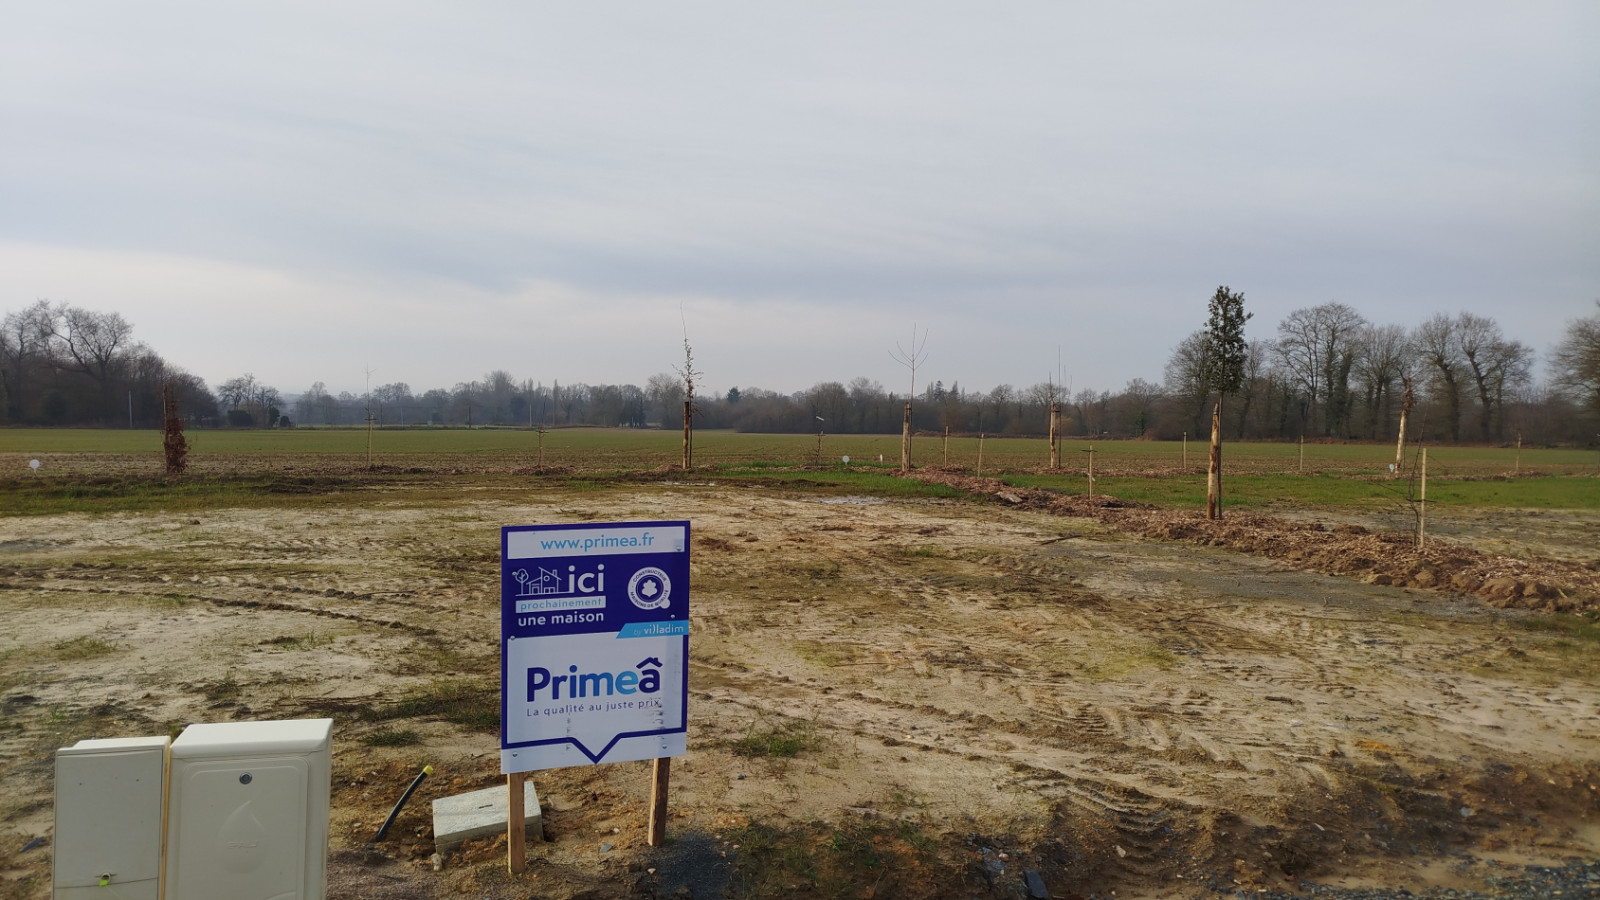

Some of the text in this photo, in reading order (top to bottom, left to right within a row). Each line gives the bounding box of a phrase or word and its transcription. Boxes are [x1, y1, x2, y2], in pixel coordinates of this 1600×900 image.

[540, 532, 654, 551] www.primea.fr
[568, 564, 604, 593] ici
[520, 598, 602, 612] prochainement
[518, 611, 604, 627] une maison
[527, 698, 659, 717] La qualité au juste prix
